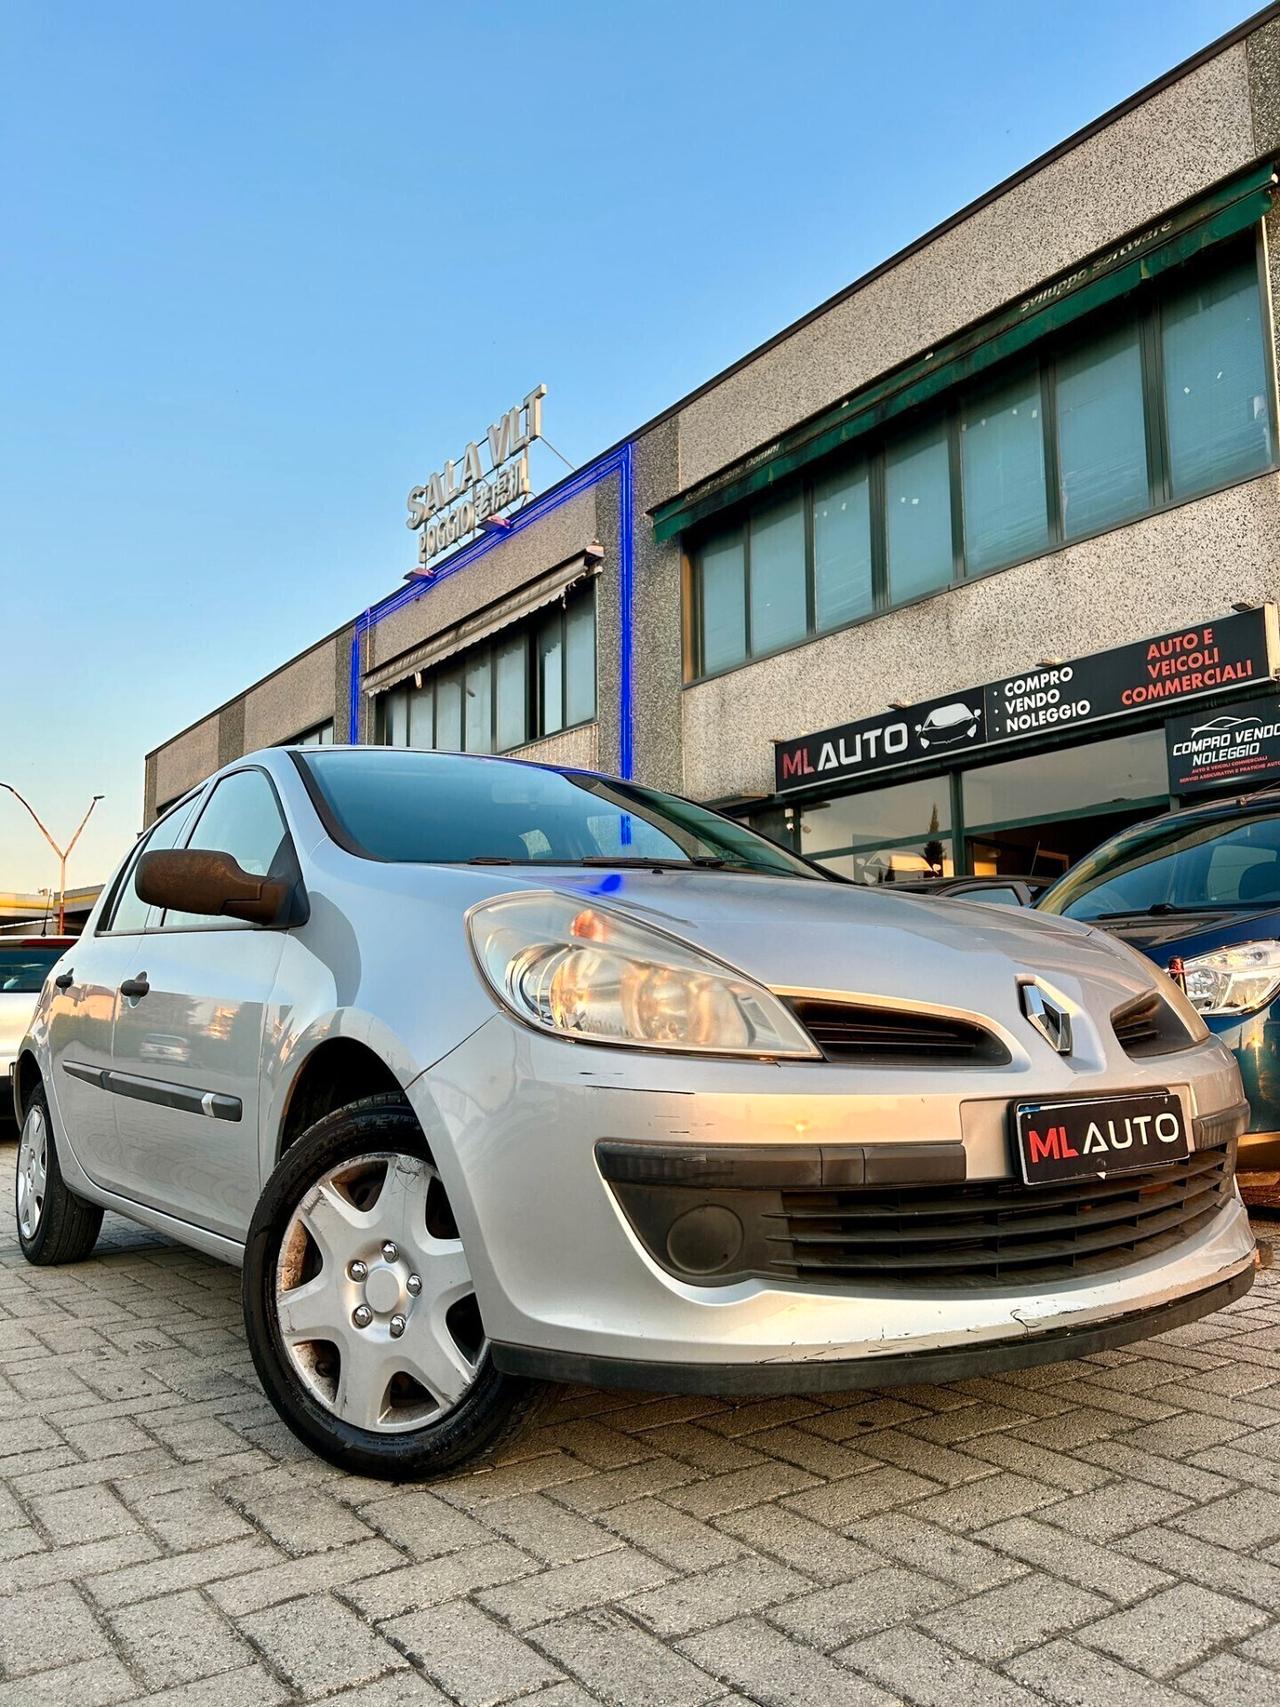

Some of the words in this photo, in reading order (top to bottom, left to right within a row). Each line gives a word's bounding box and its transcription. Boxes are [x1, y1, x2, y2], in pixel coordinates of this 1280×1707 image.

[406, 441, 482, 530] SALA
[487, 384, 548, 468] VLT
[419, 500, 475, 564] POGGIO
[1147, 633, 1198, 660] AUTO
[1204, 628, 1213, 645] E
[1147, 648, 1218, 679] VEICOLI
[1004, 666, 1074, 698] COMPRO
[1121, 660, 1253, 705] COMMERCIALI
[1005, 689, 1061, 715] VENDO
[1006, 700, 1091, 733] NOLEGGIO
[782, 747, 814, 779] ML
[817, 722, 909, 772] AUTO
[1173, 733, 1231, 756] COMPRO
[1193, 743, 1260, 766] NOLEGGIO
[1200, 770, 1235, 780] ASSICURATIVI
[1240, 763, 1266, 772] PRATICHE
[1232, 756, 1268, 767] COMMERCIALI
[1028, 1126, 1079, 1163] ML
[1083, 1113, 1180, 1154] AUTO
